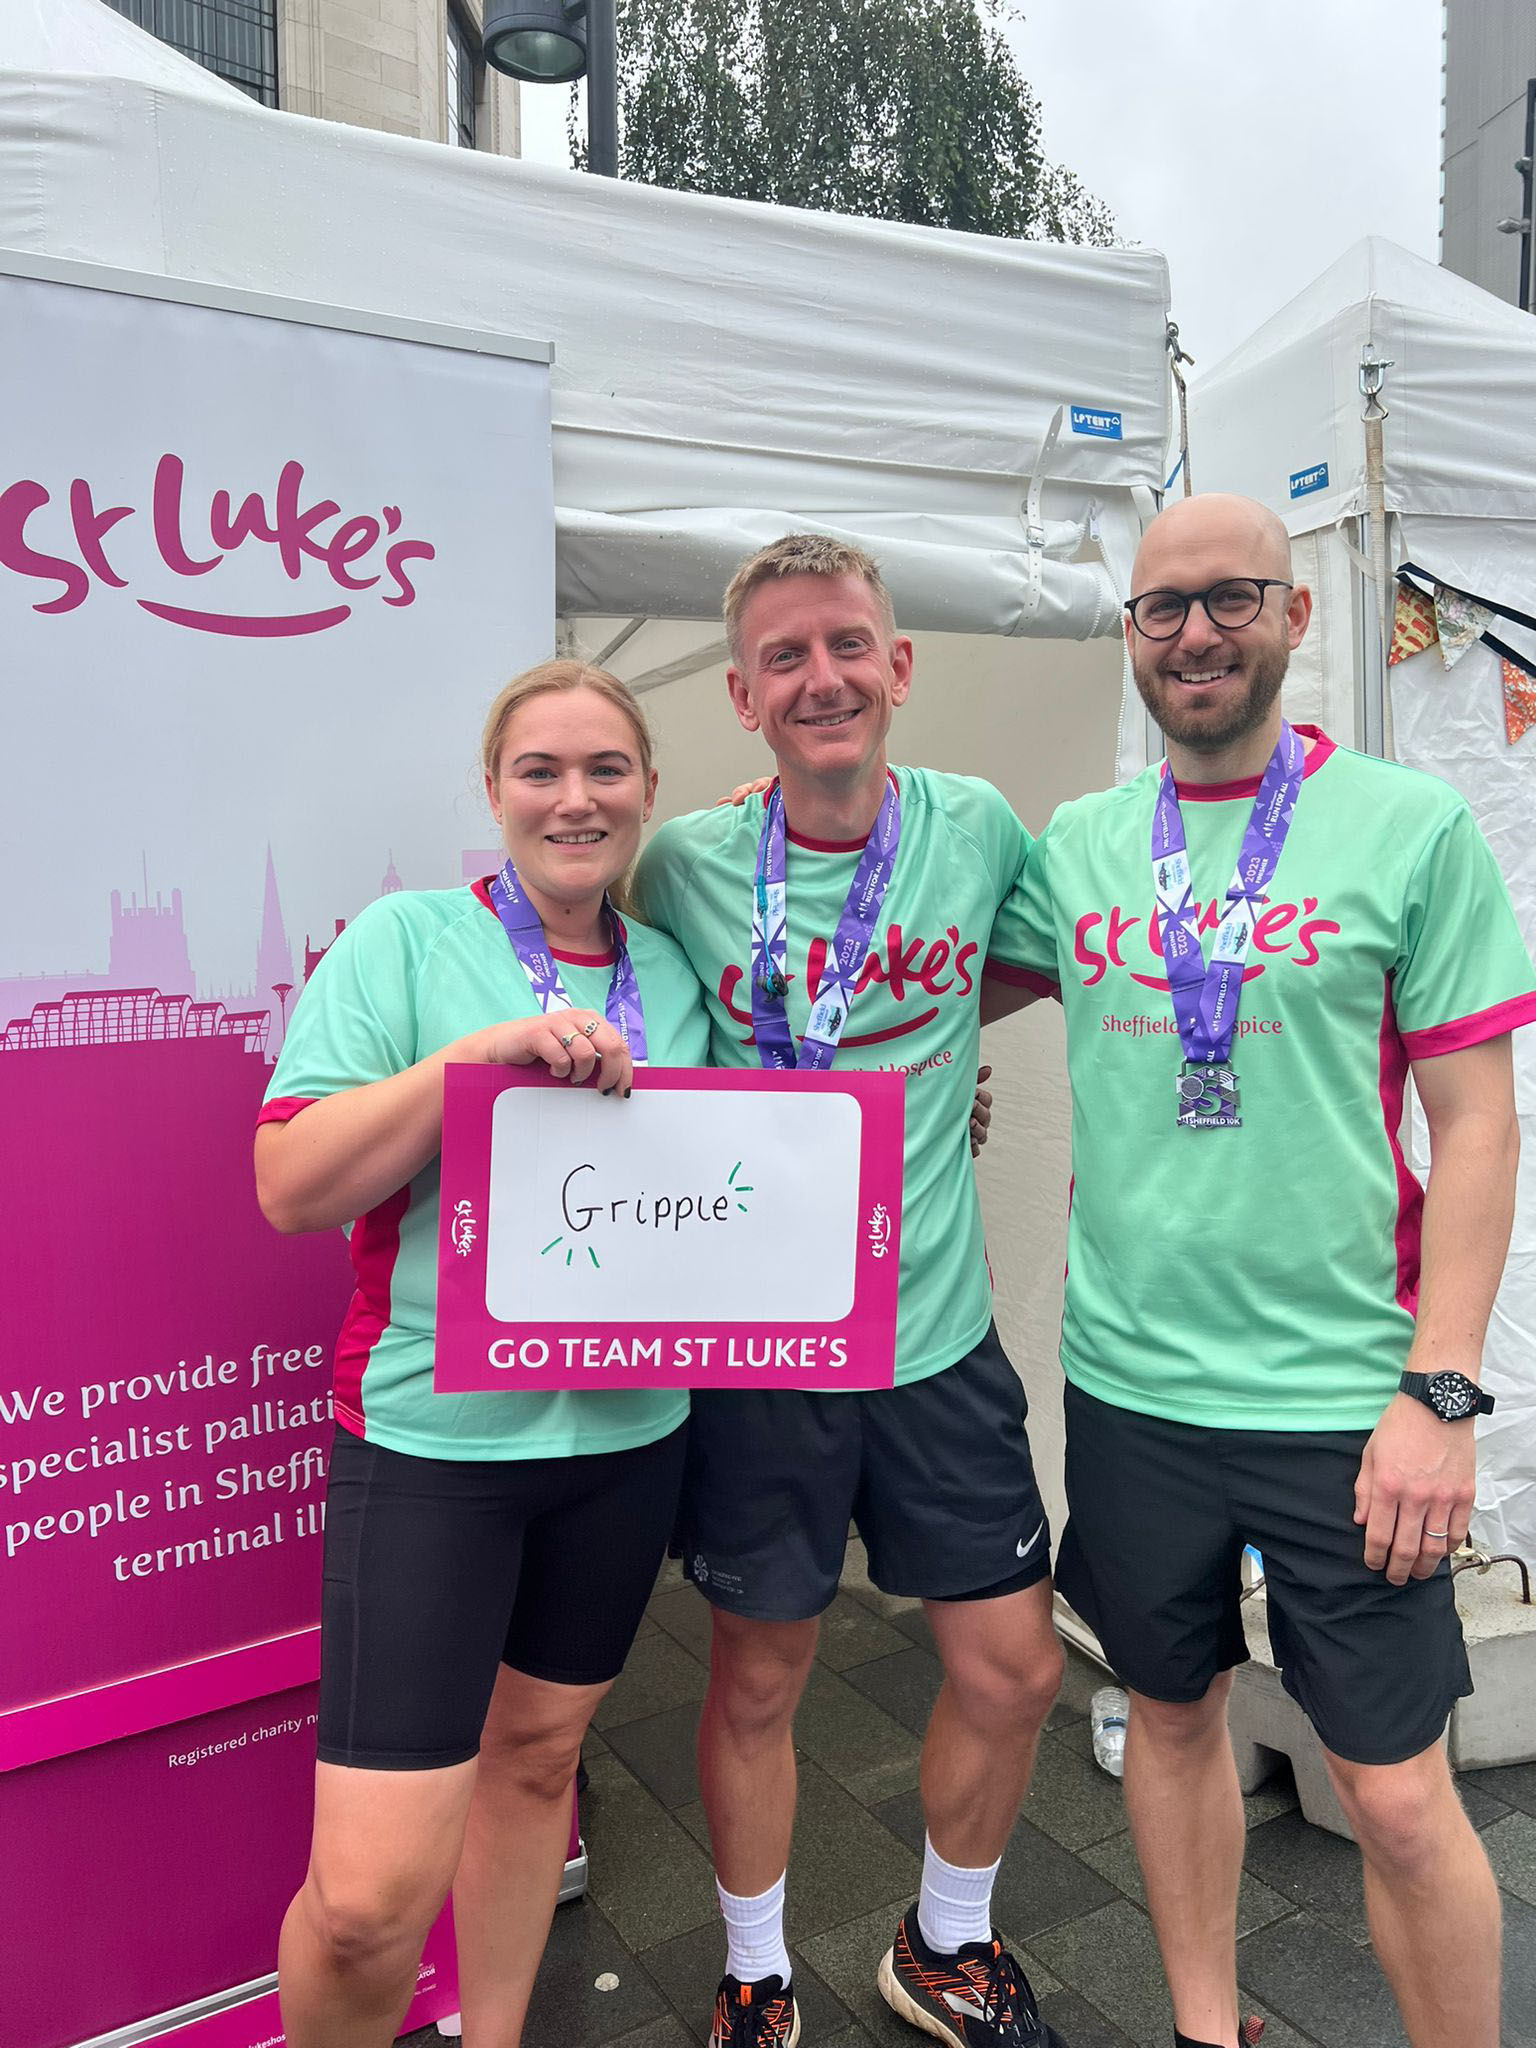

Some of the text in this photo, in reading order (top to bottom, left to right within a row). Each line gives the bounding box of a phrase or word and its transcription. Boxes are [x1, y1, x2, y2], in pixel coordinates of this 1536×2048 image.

[0, 453, 435, 614] St Luke's
[1270, 781, 1289, 823] RUN FOR ALL
[864, 860, 884, 903] RUN FOR ALL
[1243, 856, 1261, 884] 2023
[1255, 858, 1269, 884] FINISHER
[838, 938, 855, 966] 2023
[848, 941, 861, 968] FINISHER
[1074, 905, 1141, 986] St
[1168, 930, 1178, 958] FINISHER
[1175, 928, 1188, 956] 2023
[530, 952, 545, 977] 2023
[1213, 967, 1230, 1019] SHEFFIELD 10K
[1232, 1015, 1283, 1038] spice
[562, 1164, 728, 1232] Gripple
[488, 1336, 848, 1368] GO TEAM ST LUKE'S
[0, 1344, 324, 1425] We provide free
[0, 1426, 192, 1494] specialist
[5, 1447, 329, 1558] people in Sheffi
[113, 1512, 285, 1581] terminal
[168, 1713, 318, 1768] Registered charity n
